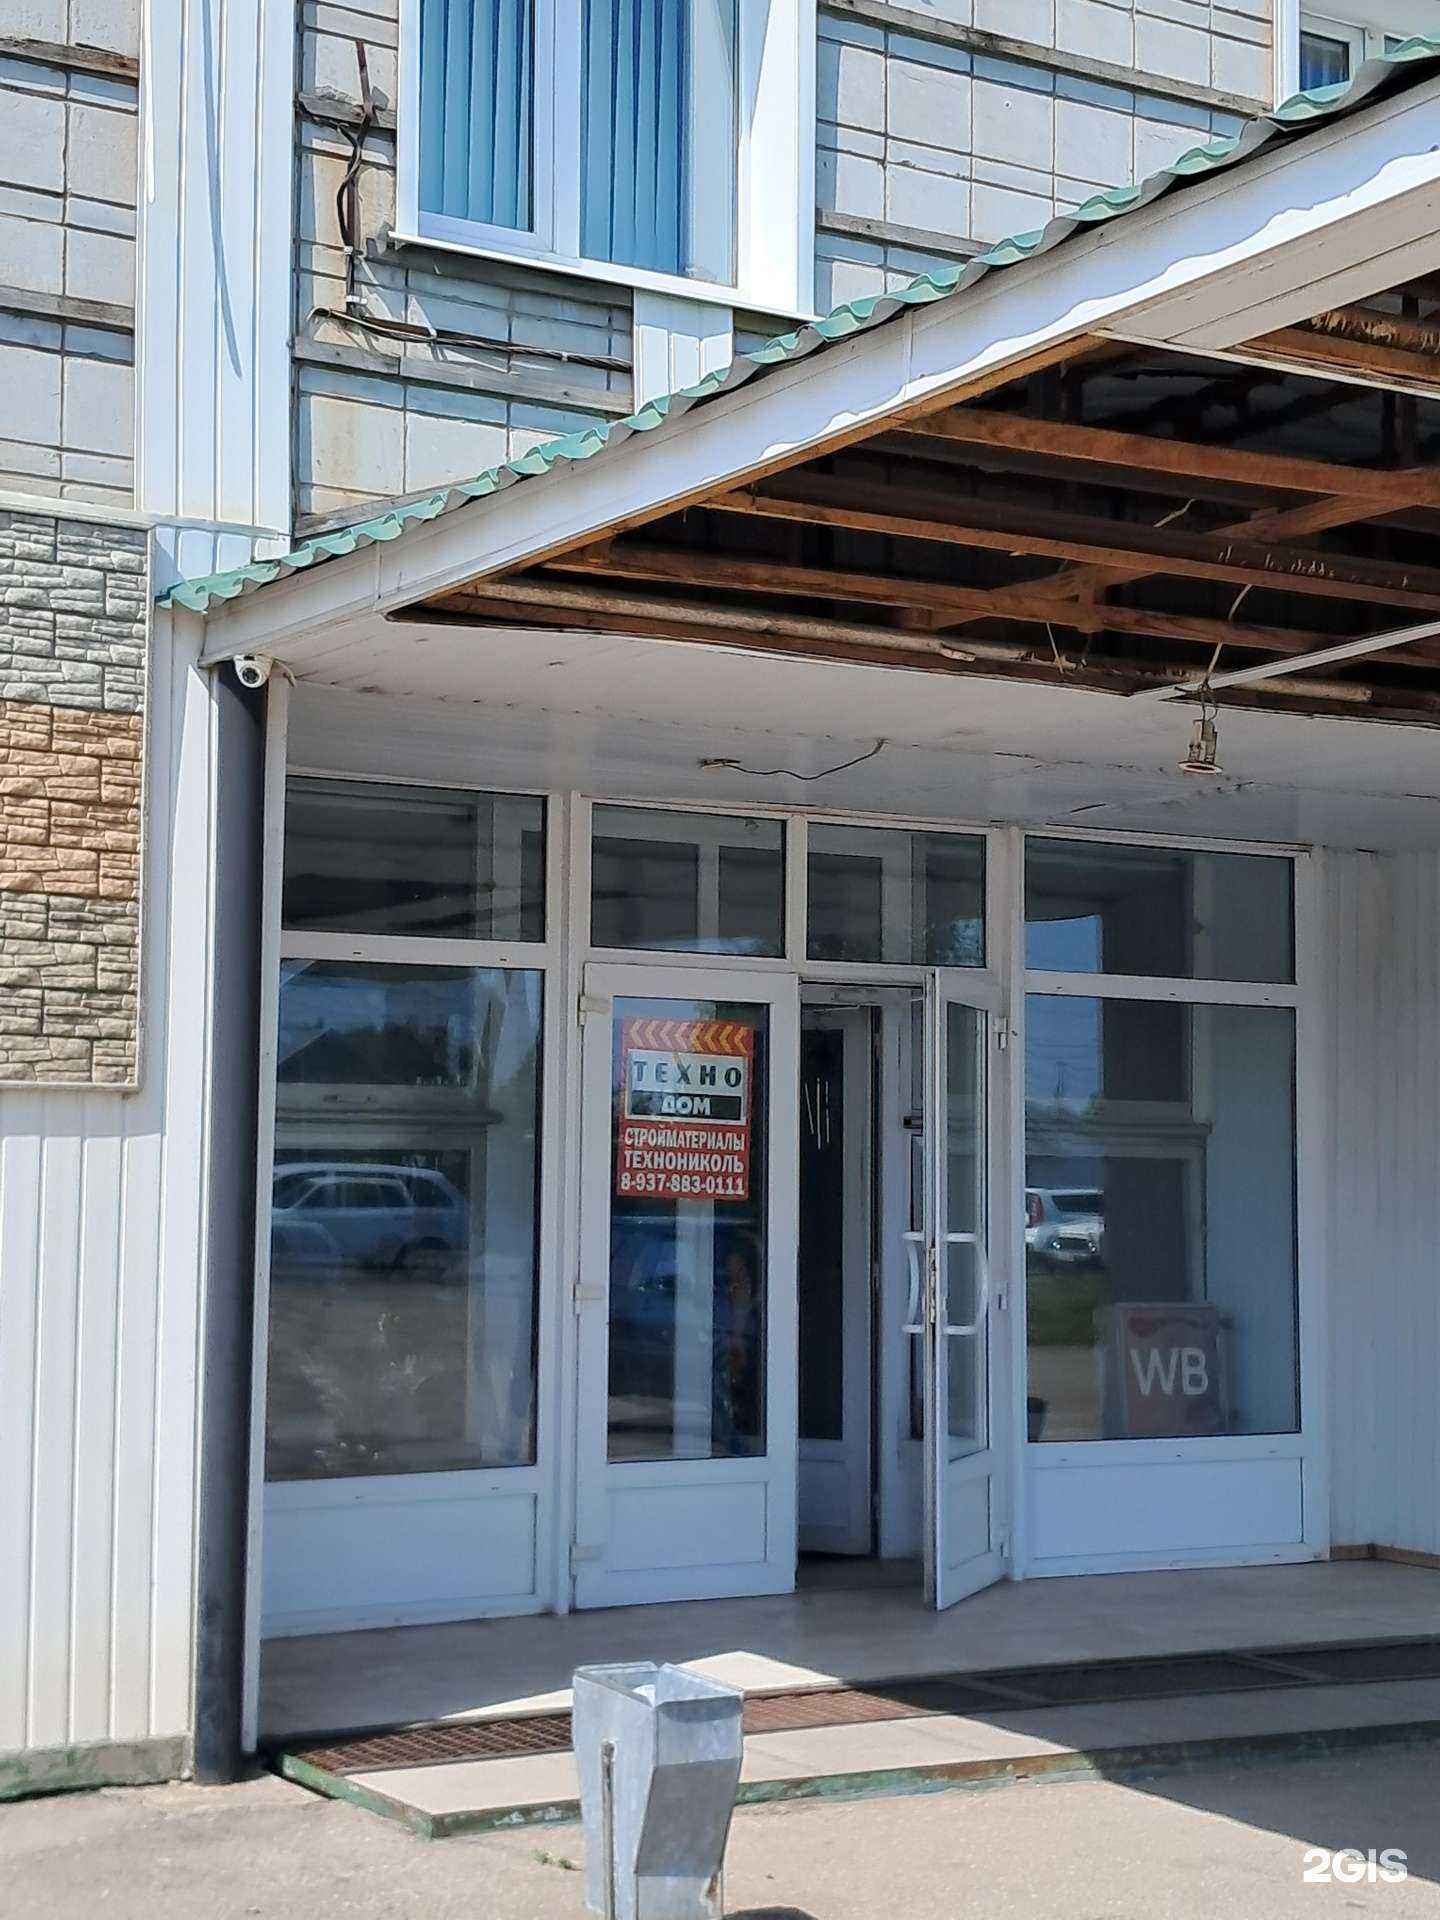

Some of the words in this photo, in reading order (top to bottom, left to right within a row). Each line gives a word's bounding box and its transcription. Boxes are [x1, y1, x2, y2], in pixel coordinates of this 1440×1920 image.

[633, 1060, 742, 1088] ТЕХНО
[661, 1095, 712, 1116] ДОМ
[624, 1125, 745, 1151] СТРОЙМАТЕРИАЛЫ
[624, 1150, 744, 1173] ТЕХНОНИКОЛЬ
[620, 1172, 744, 1195] 8-937-883-0111
[1130, 1347, 1209, 1396] WB
